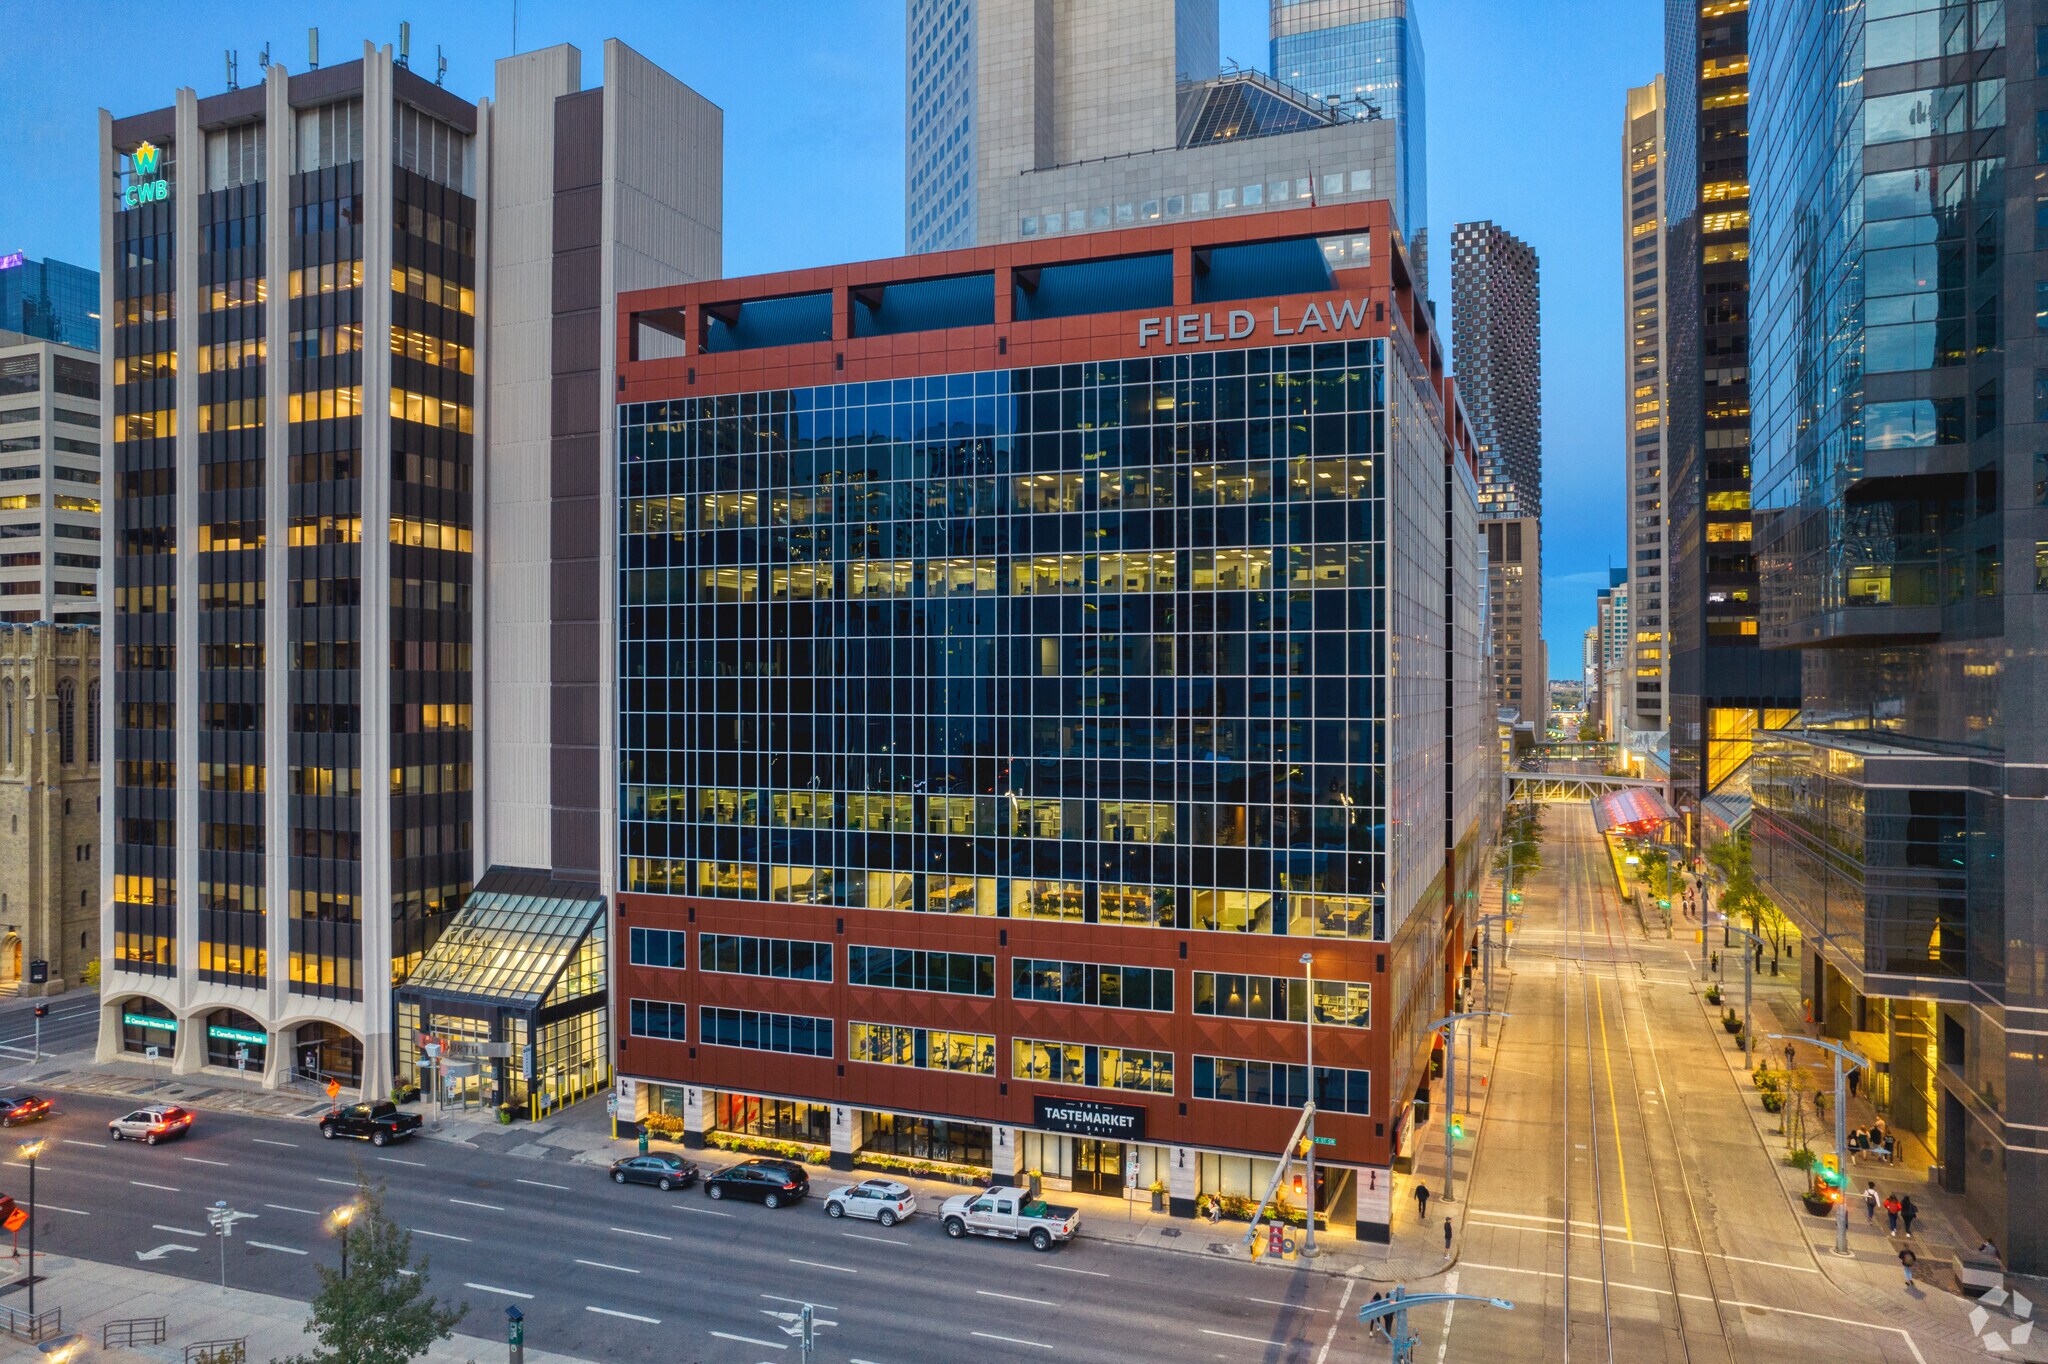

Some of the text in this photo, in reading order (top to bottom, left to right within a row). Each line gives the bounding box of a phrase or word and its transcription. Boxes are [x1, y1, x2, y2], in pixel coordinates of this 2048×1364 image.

[125, 180, 168, 206] CWB
[1139, 298, 1369, 348] FIELD LAW
[131, 1018, 149, 1026] Canadian
[149, 1020, 165, 1028] Western
[216, 1030, 263, 1043] Canadian Western Bank
[1045, 1107, 1135, 1128] TASTEMARKET
[1086, 1125, 1113, 1133] SAIT
